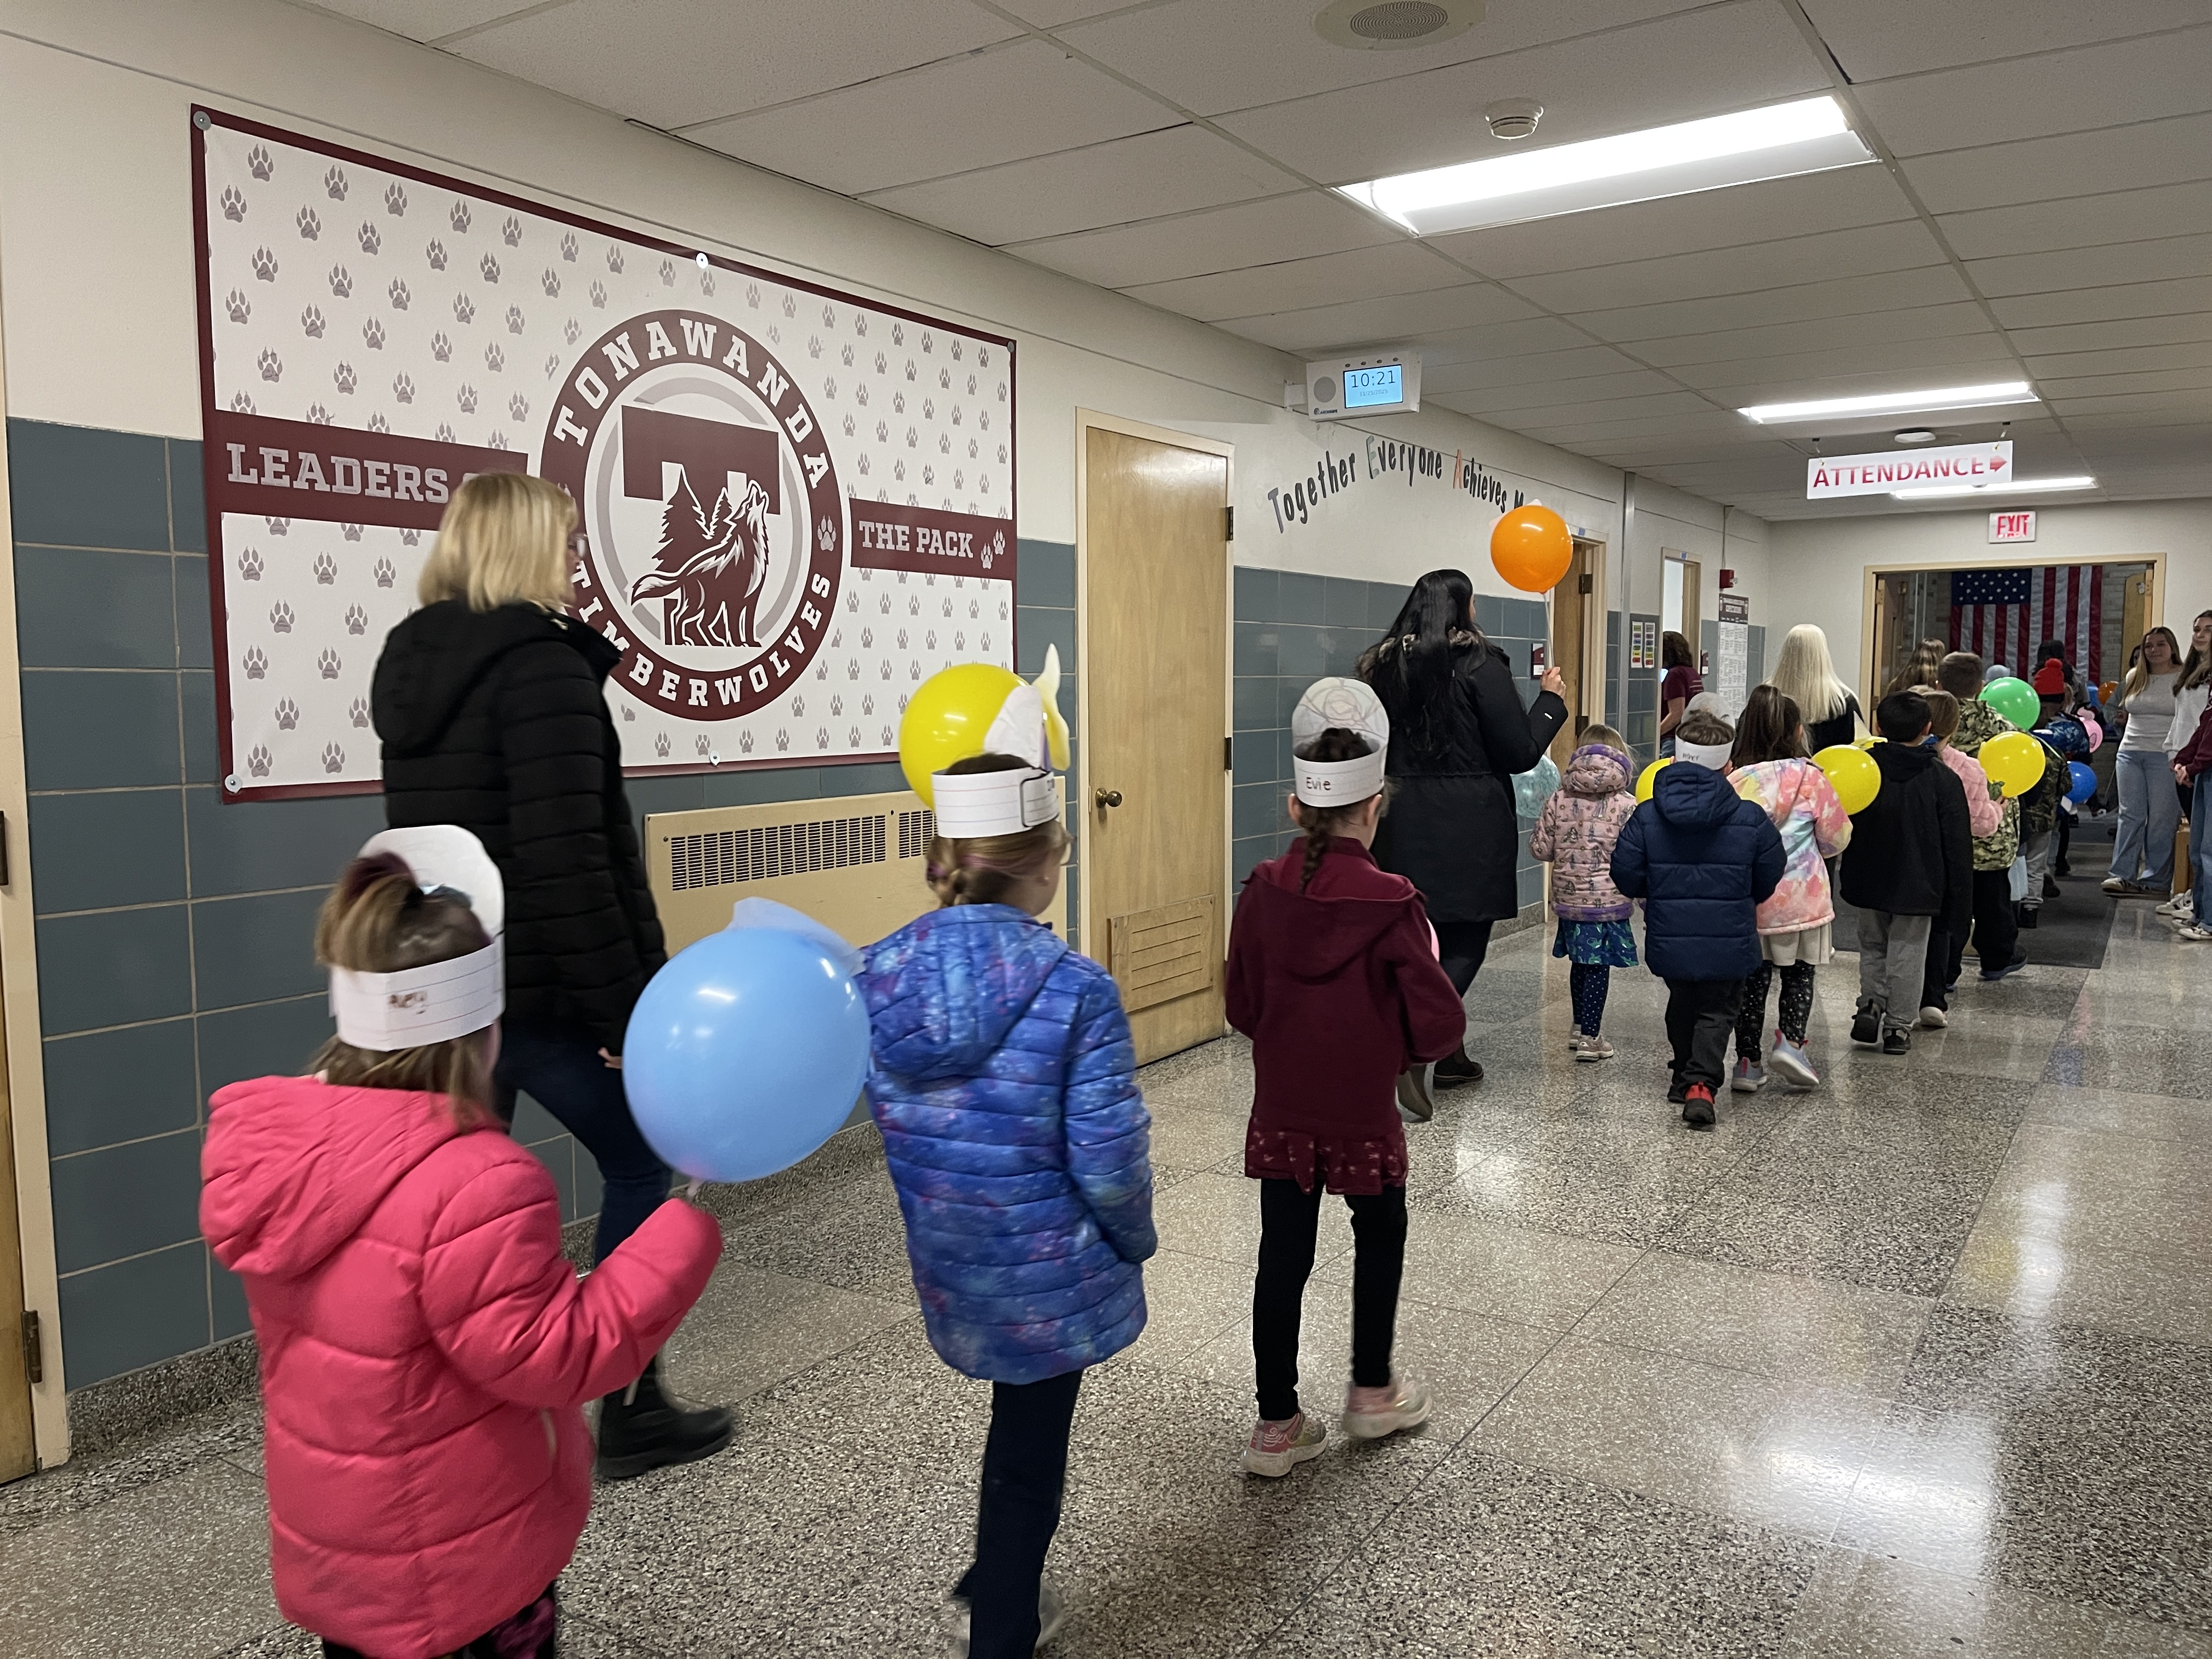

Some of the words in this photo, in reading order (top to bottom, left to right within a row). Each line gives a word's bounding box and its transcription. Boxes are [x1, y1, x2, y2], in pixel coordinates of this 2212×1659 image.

[1351, 370, 1396, 388] 10:21
[553, 318, 833, 490] TONAWANDA
[225, 443, 449, 504] LEADERS
[1267, 450, 1356, 534] Together
[1365, 435, 1442, 487] Everyone
[1453, 448, 1507, 514] Achieves
[1813, 455, 1985, 488] ATTENDANCE
[859, 520, 910, 552] THE
[917, 527, 974, 558] PACK
[1997, 514, 2030, 538] EXIT
[571, 560, 831, 708] TIMBERWOLVES
[1306, 776, 1331, 791] Evie
